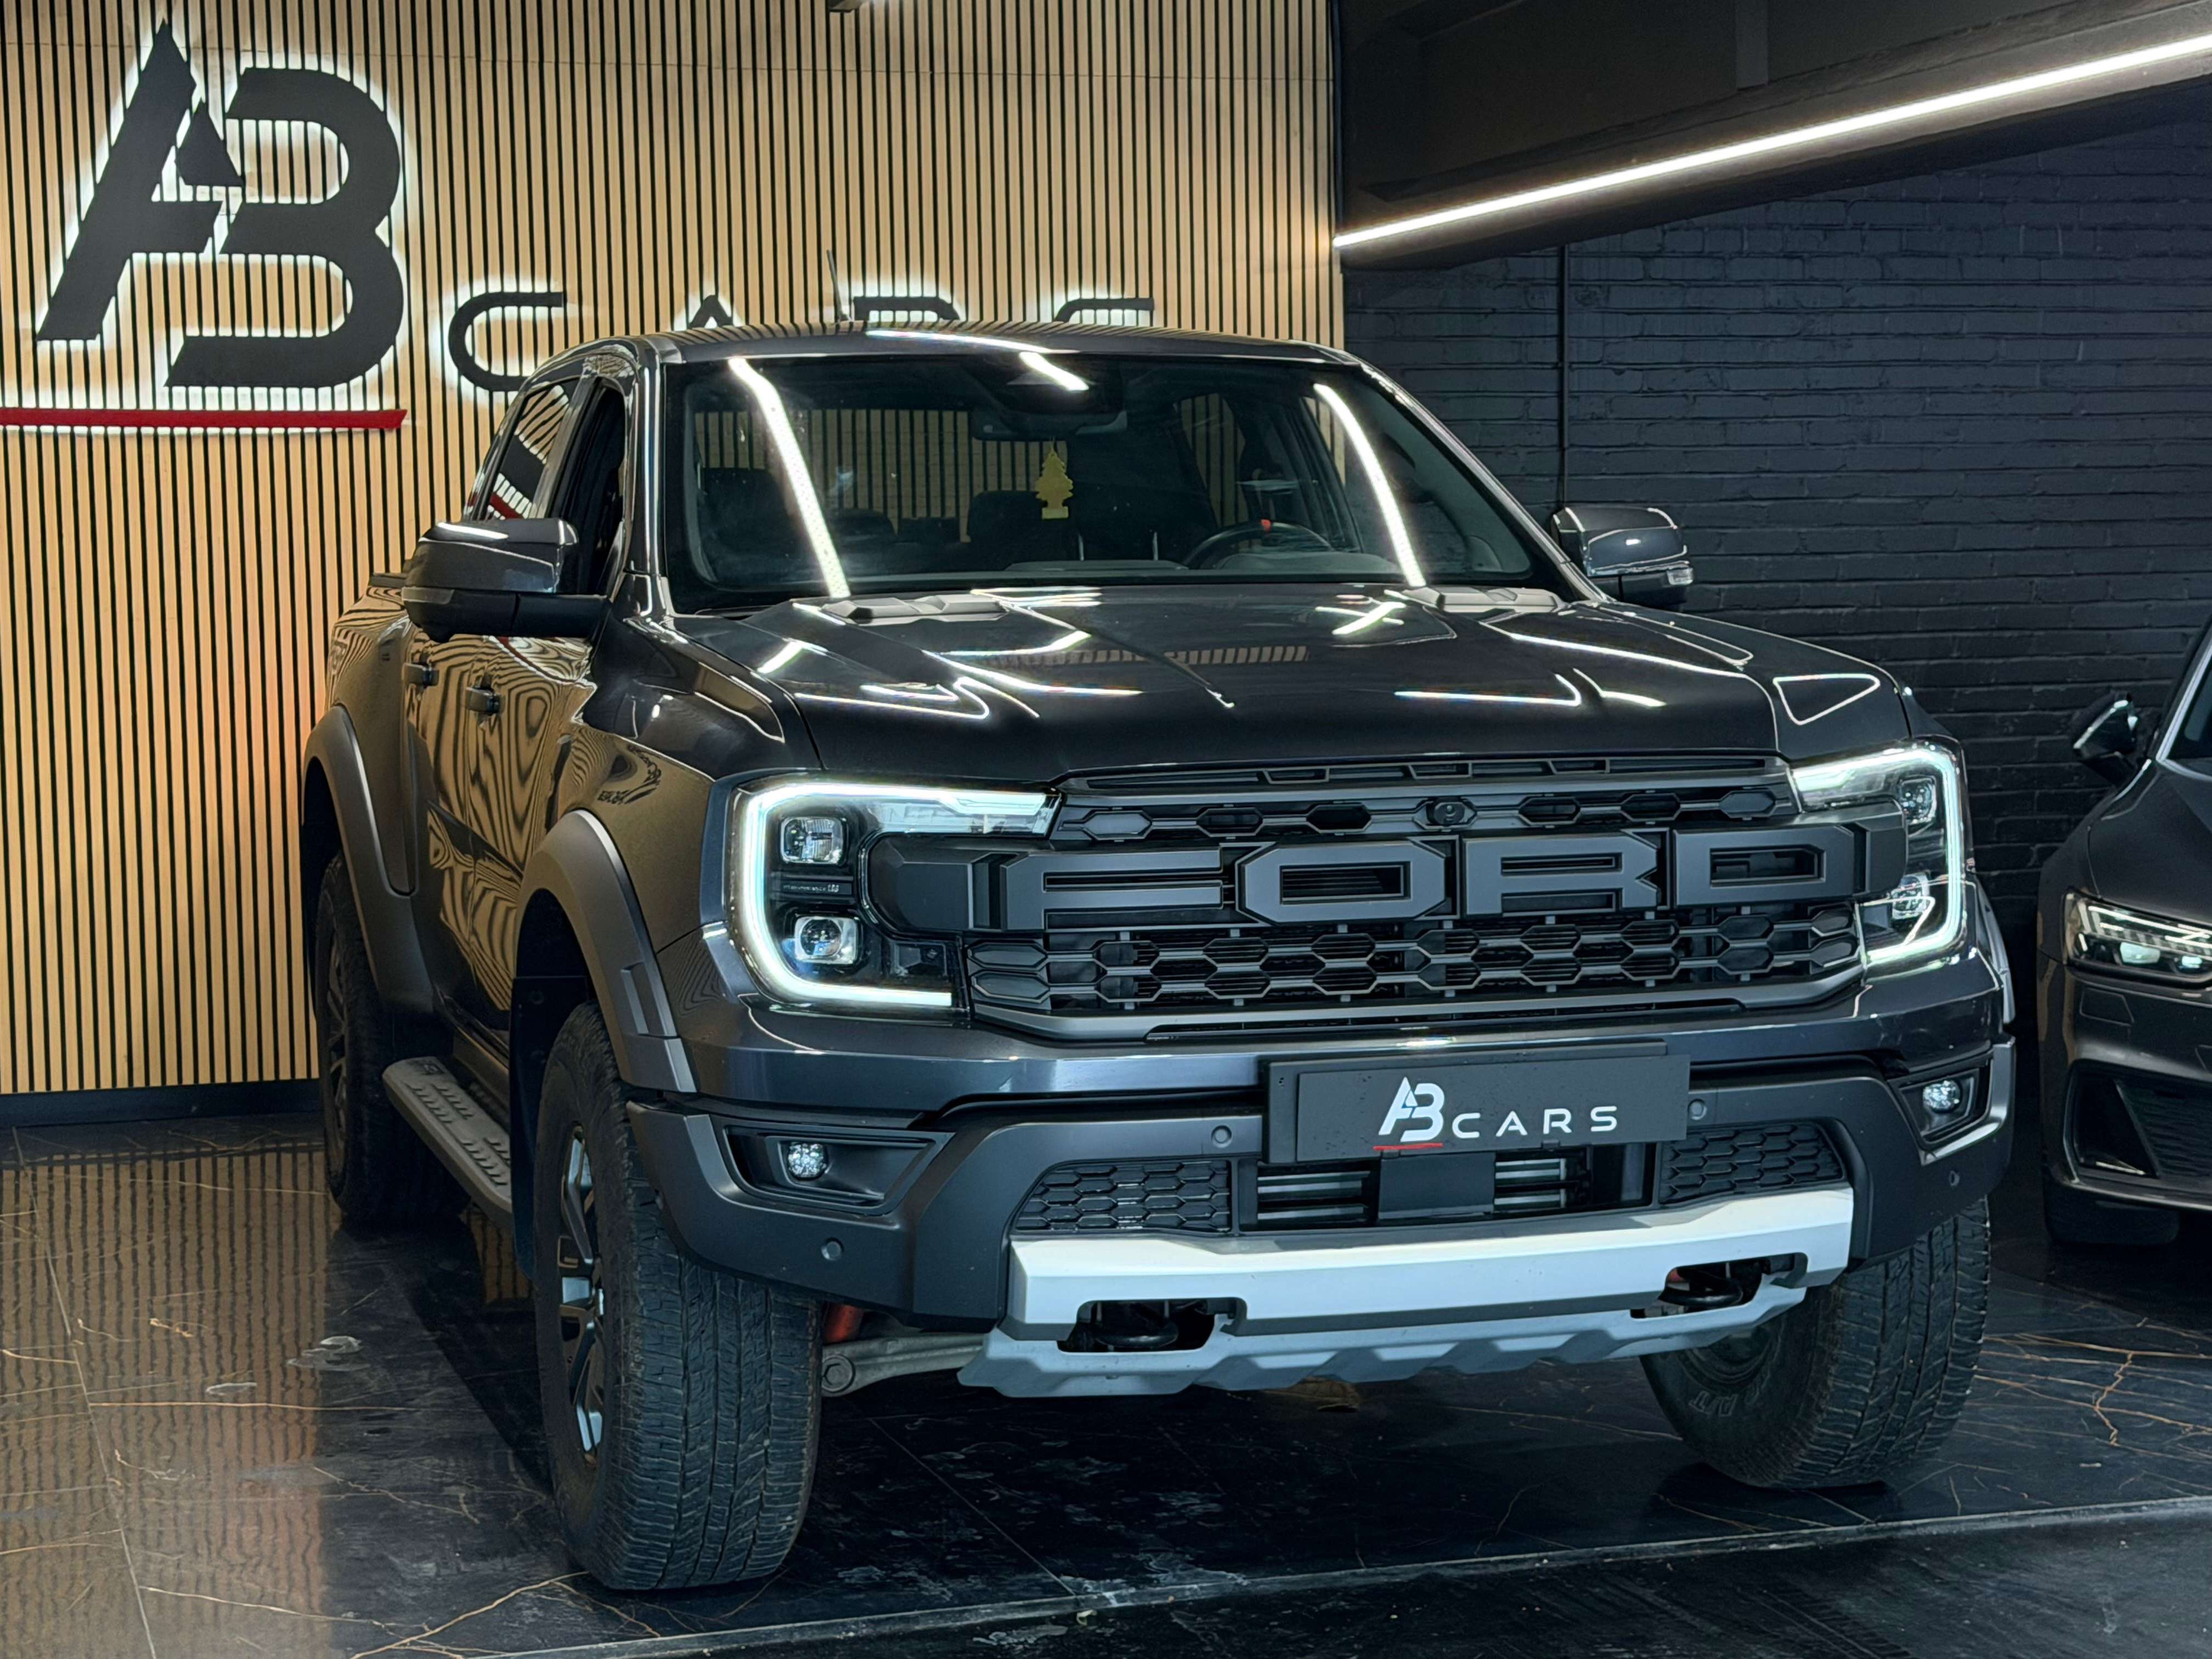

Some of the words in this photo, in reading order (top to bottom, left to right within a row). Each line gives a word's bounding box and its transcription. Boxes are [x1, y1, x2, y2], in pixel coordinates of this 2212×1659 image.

[36, 16, 404, 387] AB
[1002, 824, 1855, 931] FORD
[1378, 1076, 1445, 1143] AB
[1452, 1105, 1618, 1139] CARS
